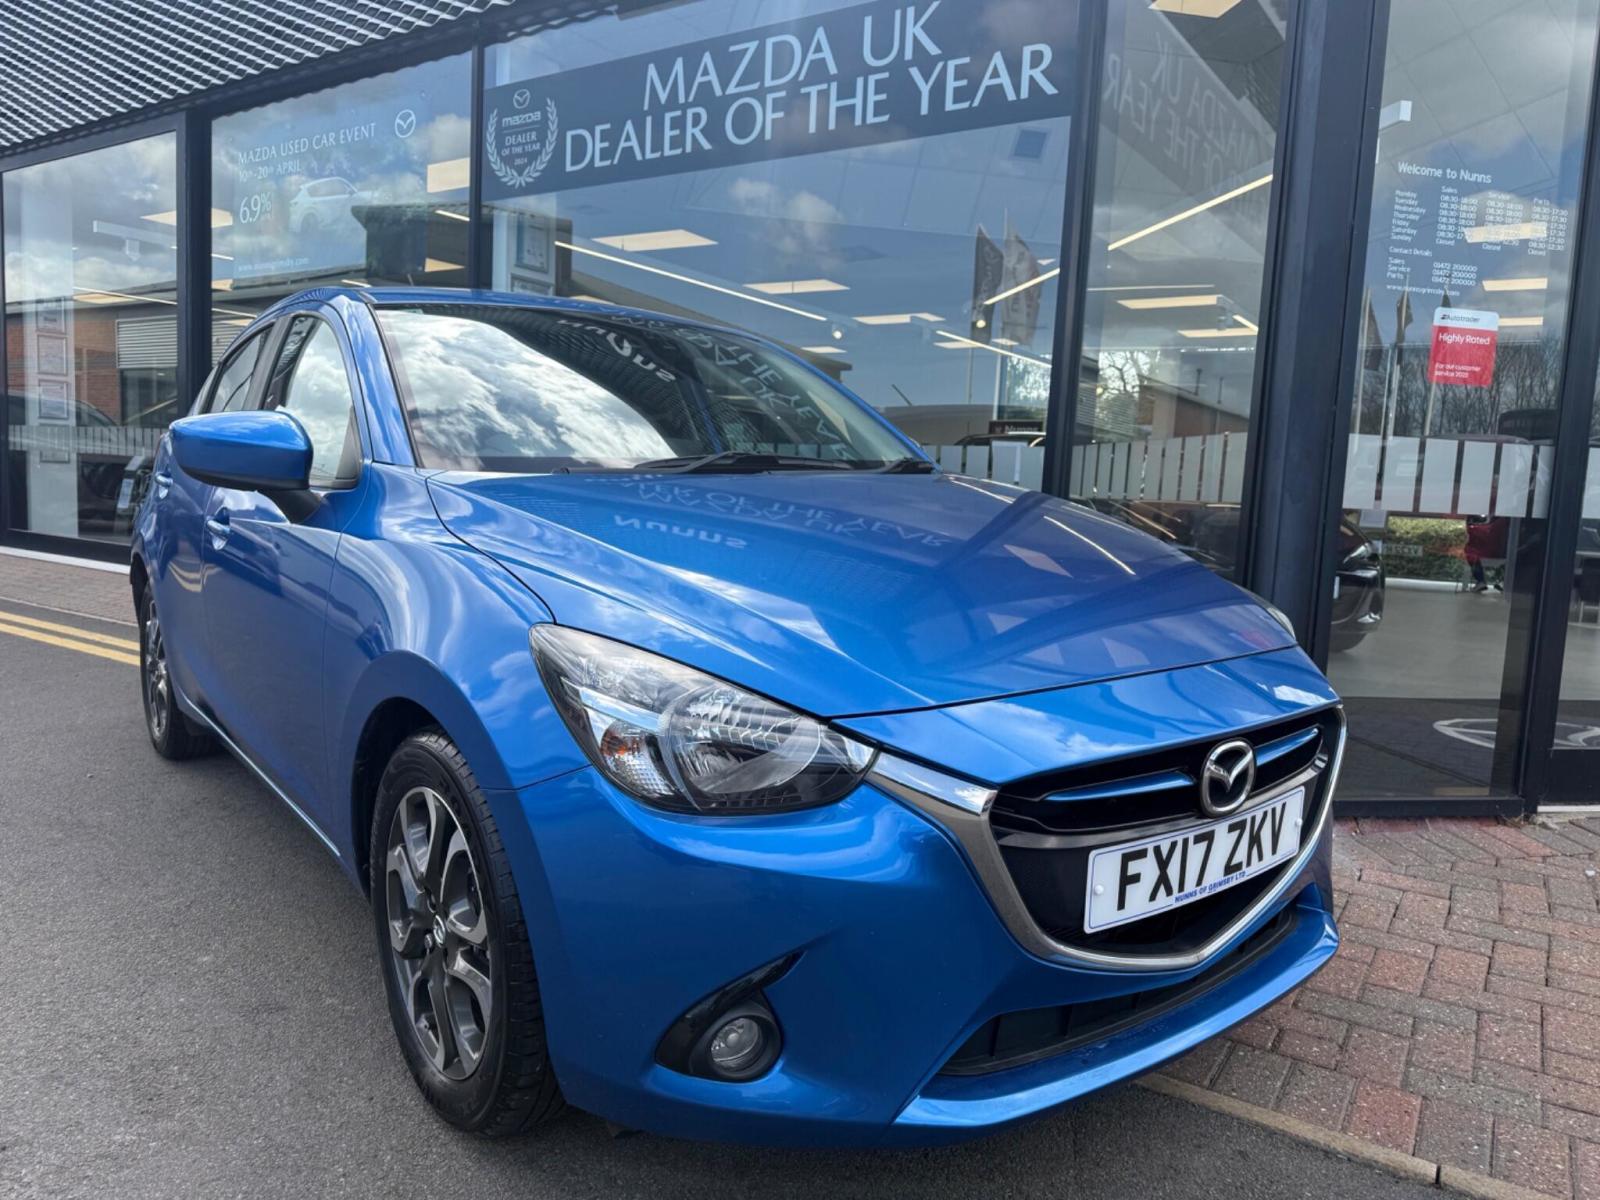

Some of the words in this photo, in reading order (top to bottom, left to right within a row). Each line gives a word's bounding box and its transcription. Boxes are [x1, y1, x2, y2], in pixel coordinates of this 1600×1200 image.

[643, 25, 838, 112] MAZDA
[862, 0, 943, 67] UK
[502, 110, 542, 128] mazda
[565, 107, 713, 174] DEALER
[724, 90, 788, 147] OF
[801, 72, 891, 136] THE
[909, 42, 1060, 117] YEAR
[239, 145, 278, 165] MAZDA
[280, 138, 309, 157] USED
[312, 132, 336, 150] CAR
[340, 122, 376, 144] EVENT
[505, 131, 537, 146] DEALER
[511, 146, 523, 155] THE
[277, 159, 301, 176] APRIL
[1398, 161, 1443, 178] Welcome
[1446, 168, 1457, 180] to
[1459, 168, 1493, 184] Nunns
[1439, 332, 1465, 345] Highly
[1466, 334, 1491, 345] Rated
[1117, 829, 1216, 912] FX17
[1223, 801, 1287, 877] ZKV
[1174, 889, 1198, 904] NUNNS
[1199, 885, 1208, 895] OF
[1208, 876, 1234, 892] GRIMSBY
[1235, 870, 1247, 881] LTD
